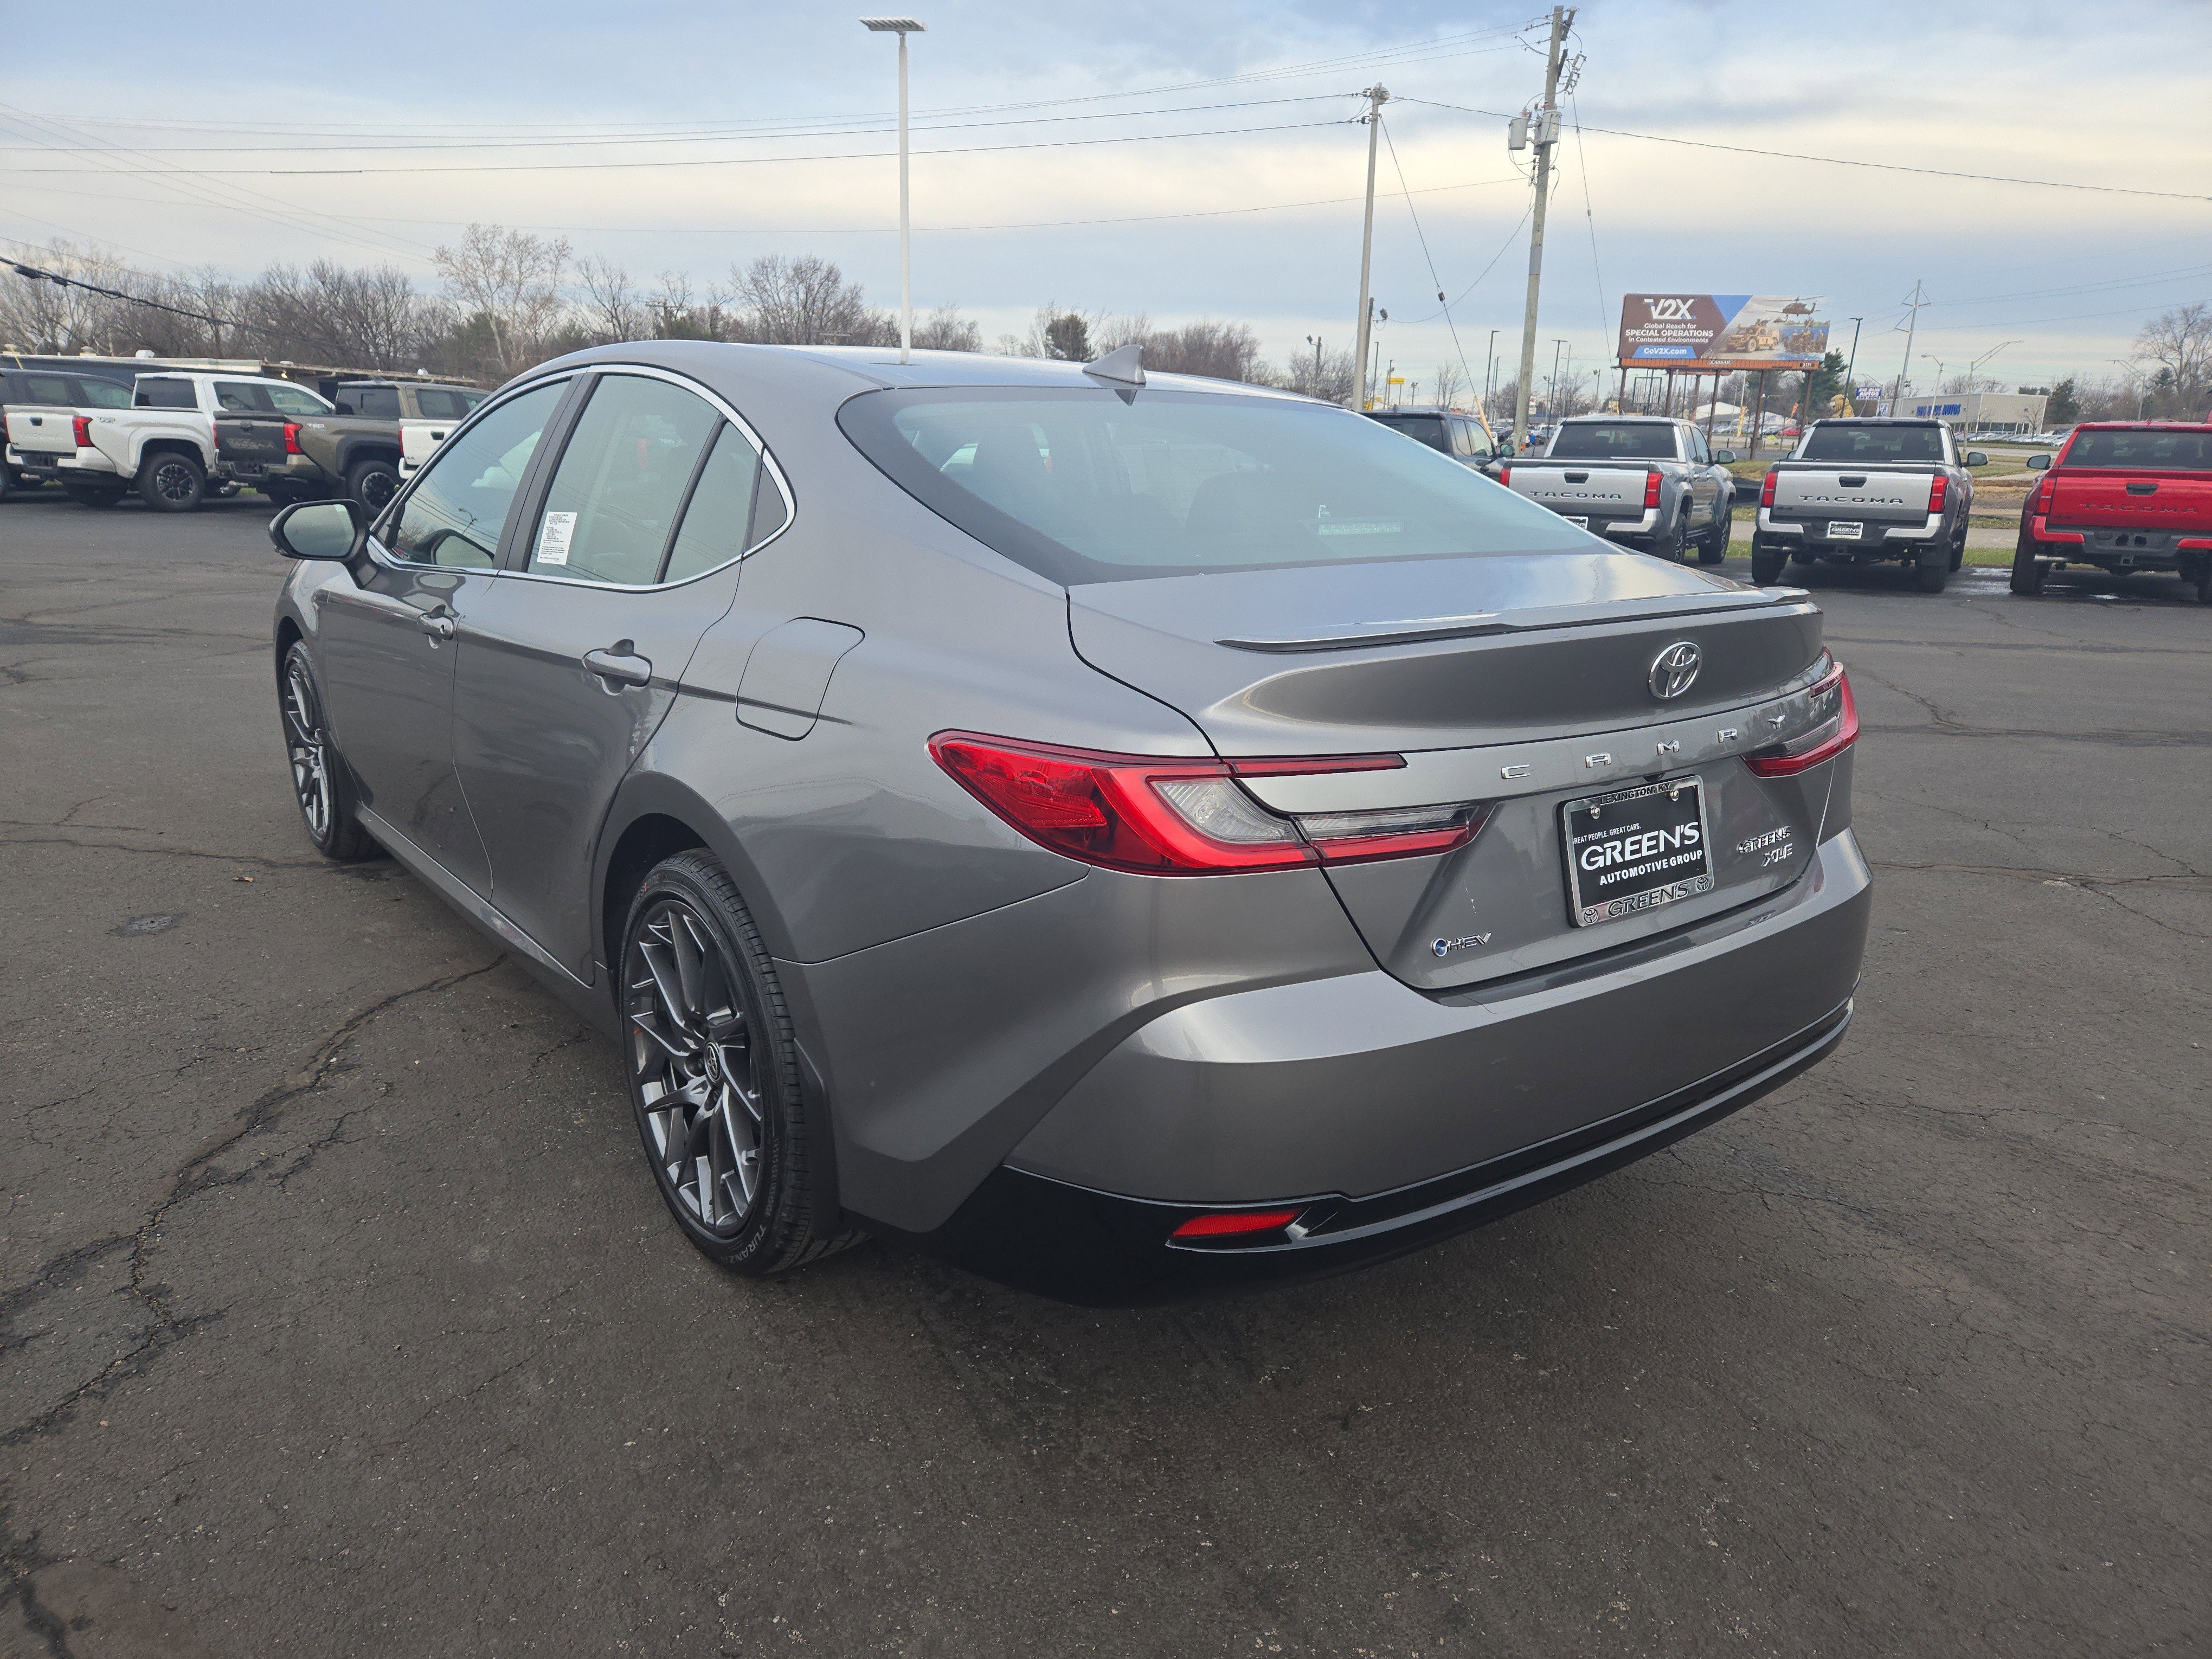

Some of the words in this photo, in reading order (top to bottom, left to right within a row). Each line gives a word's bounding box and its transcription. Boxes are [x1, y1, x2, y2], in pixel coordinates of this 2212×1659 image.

[1644, 298, 1695, 320] V2X
[1529, 491, 1622, 501] TACOMA
[1799, 495, 1904, 505] TACOMA
[2080, 503, 2197, 513] TACOMA
[1501, 714, 1786, 780] CAMRY
[1657, 782, 1671, 792] KY
[1588, 830, 1609, 841] PEOPLE.
[1609, 826, 1626, 836] GREAT
[1626, 822, 1642, 832] CARS.
[1581, 821, 1700, 870] GREEN'S
[1600, 858, 1669, 885] AUTOMOTIVE
[1670, 850, 1702, 866] GROUP
[1607, 883, 1689, 917] GREEN'S
